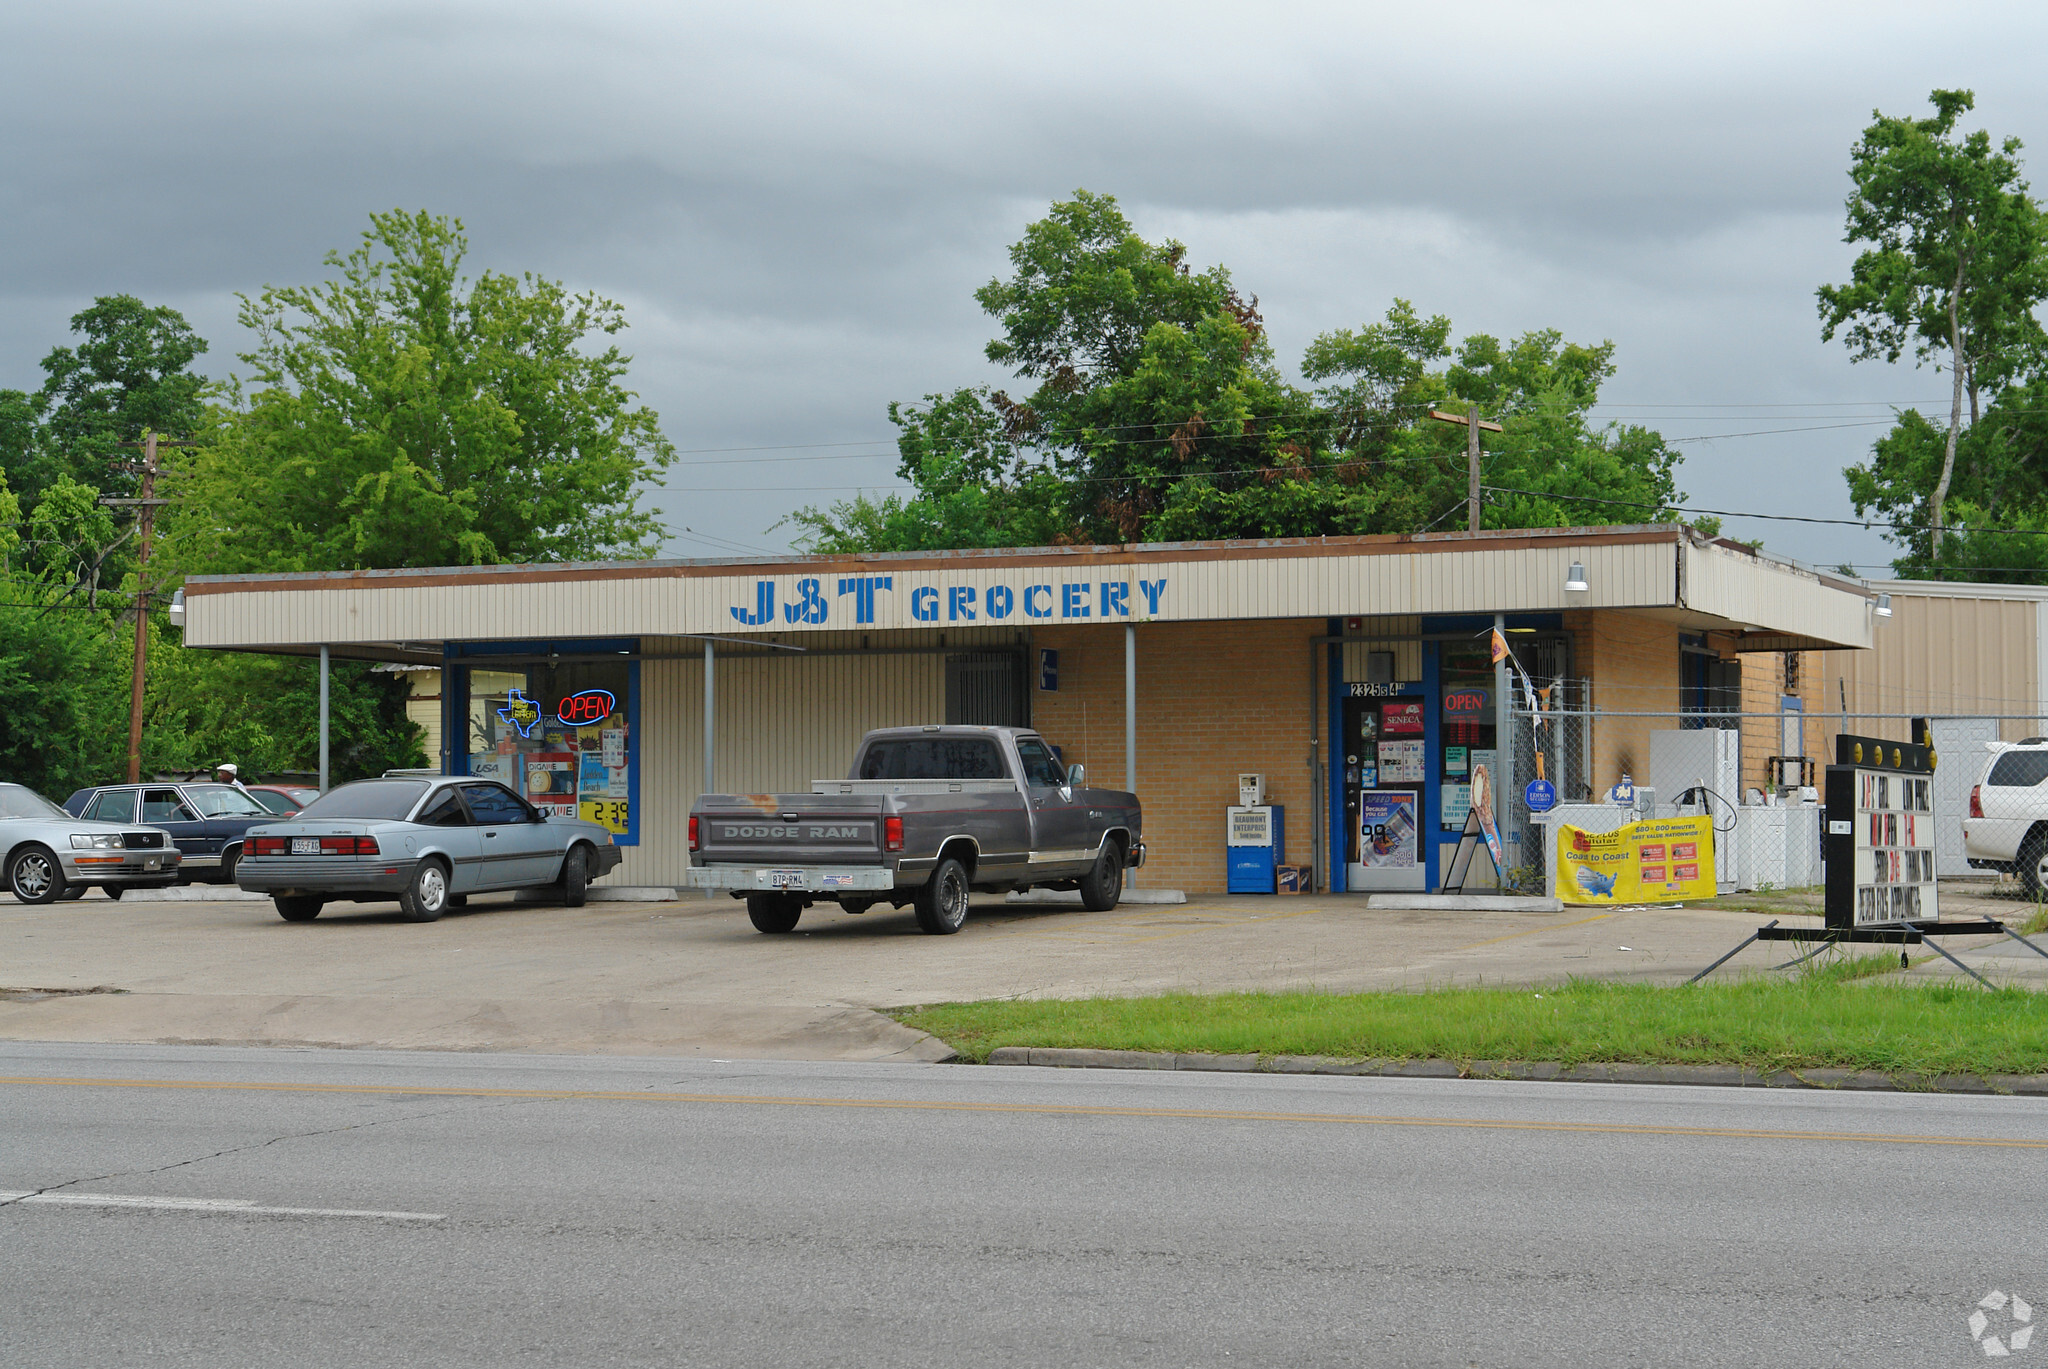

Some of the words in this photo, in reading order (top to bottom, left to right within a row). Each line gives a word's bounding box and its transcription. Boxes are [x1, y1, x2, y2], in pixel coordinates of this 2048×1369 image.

[911, 579, 1167, 622] GROCERY
[1352, 683, 1379, 696] 2325
[559, 696, 611, 719] OPEN
[1445, 694, 1482, 710] OPEN
[1387, 716, 1421, 724] SENECA
[476, 764, 499, 773] USA
[1235, 815, 1266, 823] BEAUMONT
[724, 826, 800, 838] DODGE
[809, 826, 859, 838] RAM
[1590, 852, 1600, 861] to
[1603, 852, 1629, 861] Coast
